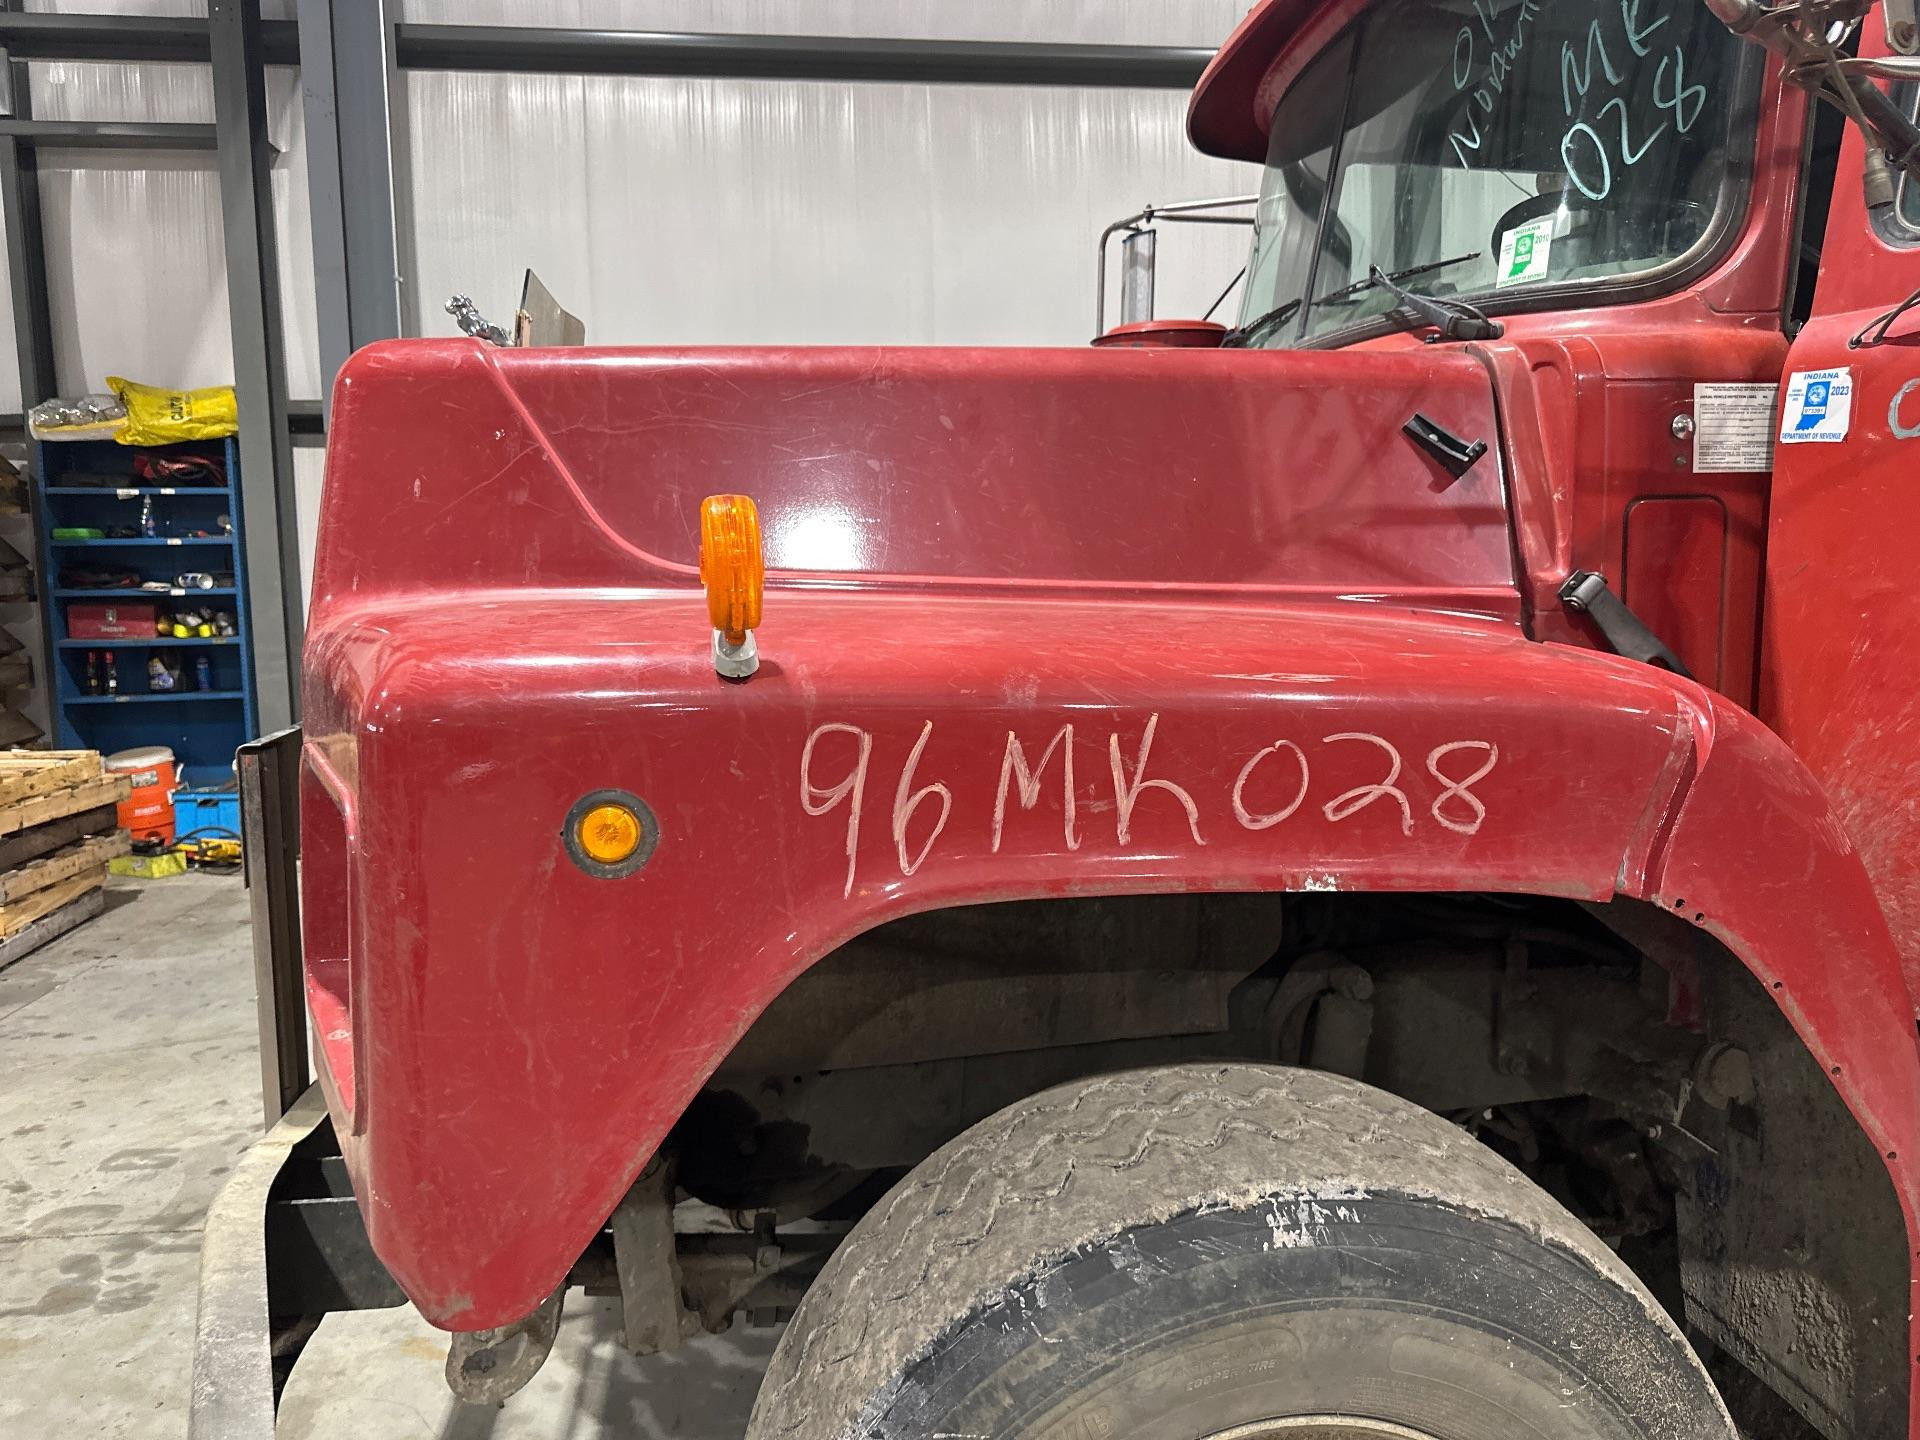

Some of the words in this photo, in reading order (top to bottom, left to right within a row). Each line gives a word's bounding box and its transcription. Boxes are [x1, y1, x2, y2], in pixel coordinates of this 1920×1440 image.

[1561, 45, 1706, 201] 028
[1513, 225, 1541, 236] INDIANA
[1803, 372, 1840, 381] INDIANA
[1830, 385, 1850, 397] 2023
[1781, 432, 1812, 440] DEPARTMENT
[1811, 432, 1819, 440] OF
[1819, 432, 1842, 440] REVENUE
